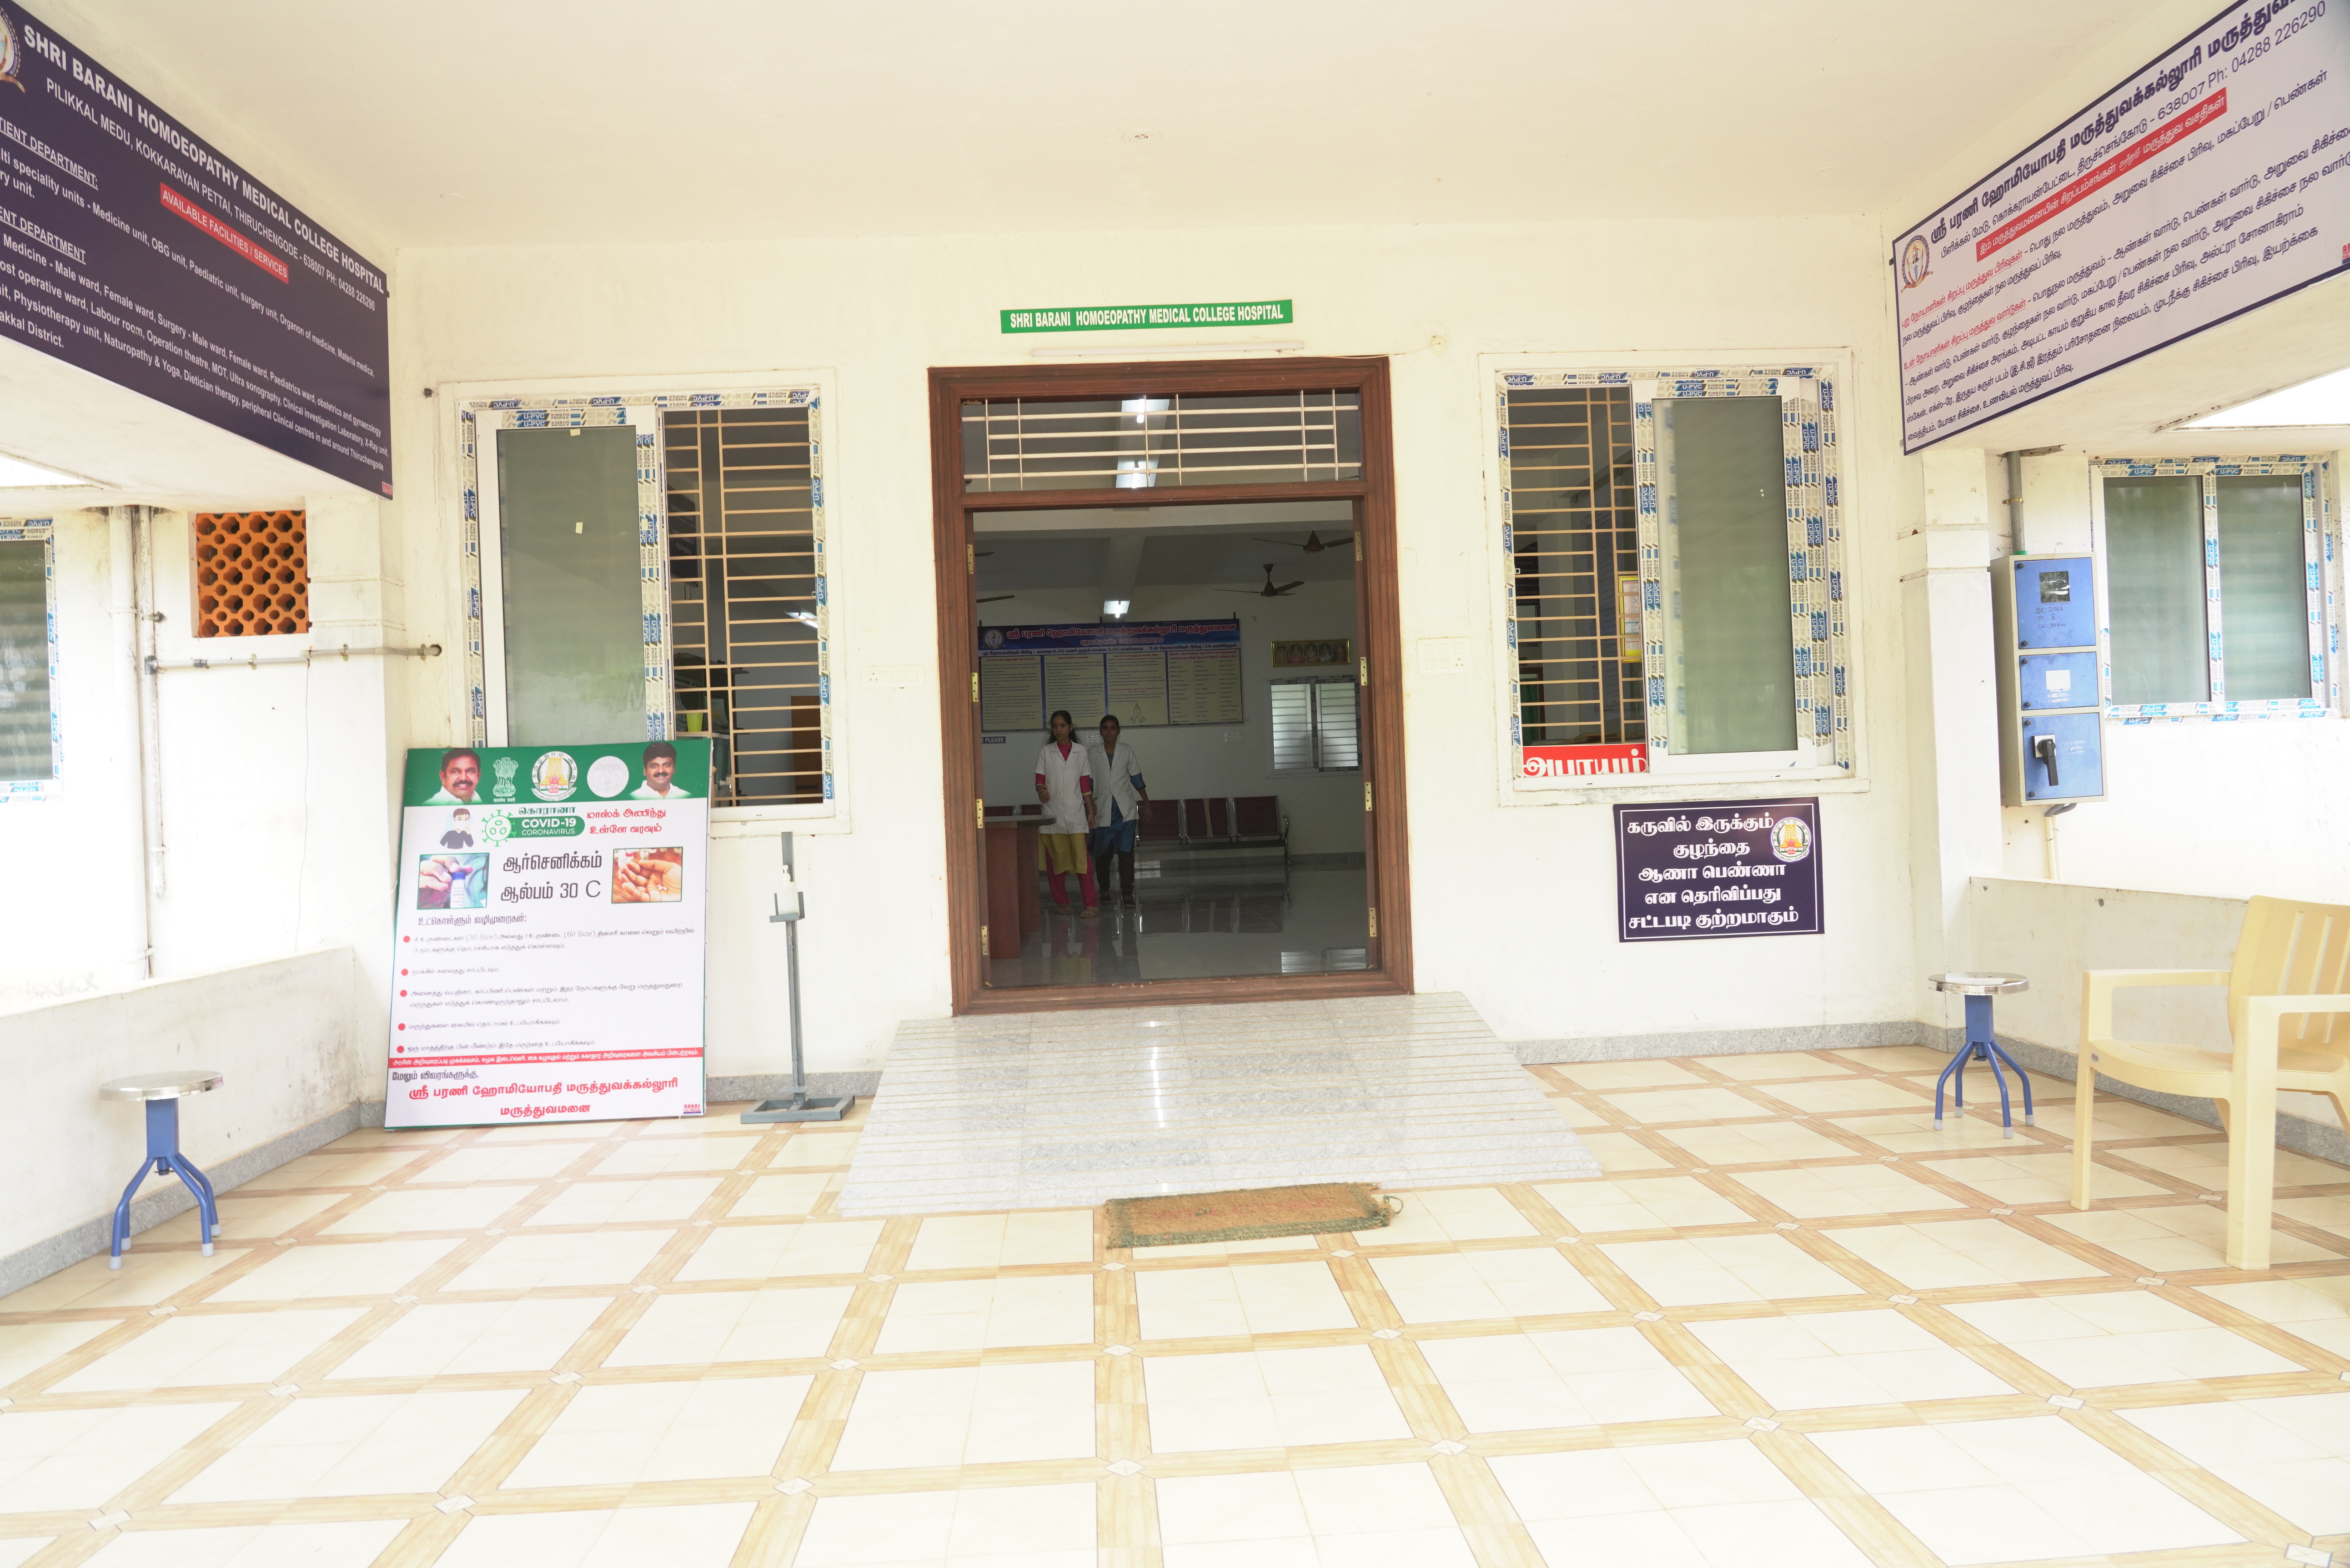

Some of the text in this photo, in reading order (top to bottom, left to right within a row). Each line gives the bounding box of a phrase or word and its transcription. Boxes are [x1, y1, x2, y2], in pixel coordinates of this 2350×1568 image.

[1941, 231, 1971, 259] பிளிக்கல்
[1972, 220, 1991, 238] மேடு,
[2077, 118, 2148, 176] திருச்செங்கோடு
[2158, 80, 2205, 120] 638007
[2208, 67, 2228, 89] Ph:
[2231, 36, 2271, 73] 04288
[2275, 1, 2325, 46] 226290
[1949, 196, 1978, 230] பரணி
[1981, 138, 2066, 208] ஹோமியோபதி
[2070, 45, 2202, 150] மருத்துவக்கல்லூரி
[24, 24, 66, 71] SHRI
[72, 57, 133, 117] BARANI
[138, 104, 239, 191] HOMOEOPATHY
[242, 179, 292, 230] MEDICAL
[294, 218, 339, 264] COLLEGE
[341, 251, 384, 295] HOSPITAL
[30, 136, 98, 188] DEPARTMENT:
[1980, 239, 1992, 256] இம்
[1993, 198, 2059, 246] மருத்துவமனையின்
[2143, 122, 2184, 154] மருத்துவ
[2185, 95, 2224, 128] வசதிகள்
[46, 77, 375, 312] PILIKKAL MEDU, KOKKARAYAN PETTAI, THIRUCHENGODE 638007 PH: 04288 226290
[163, 190, 287, 278] AVAILABLE FACILITIES SERVICES
[1902, 249, 2023, 327] புற நோயாளிகள் சிறப்பு மருத்துவ பிரிவுகள்
[1903, 250, 2062, 347] நல மருத்துவப் பிரிவு, குழந்தைகள் நல மருத்துவப் பிரிவு.
[1010, 304, 1284, 328] SHRI BARANI HOMOEOPATHY MEDICAL COLLEGE HOSPITAL
[28, 320, 64, 348] District.
[14, 289, 384, 471] Physiotherapy unit, Naturopathy Yoga, Dietician therapy, peripheral Clinical centres in and around Thiruchengode
[1908, 363, 2074, 441] வைத்தியம், யோகா சிகிச்சை, உணவியல் மருத்துவப் பிரிவு.
[1021, 628, 1045, 639] பரணி
[1046, 626, 1105, 638] ஹோமியோபதி
[1105, 624, 1178, 637] மருத்துவக்கல்லூரி
[1178, 622, 1237, 635] மருத்துவமனை
[518, 807, 576, 815] கொரானா
[522, 818, 577, 828] COVID-19
[587, 808, 666, 819] மாஸ்க் அணிந்து
[521, 828, 575, 836] CORONAVIRUS
[589, 823, 662, 834] உள்ளே வரவும்
[1627, 812, 1775, 837] கருவில் இருக்கும்
[1673, 838, 1750, 860] குழந்தை
[503, 850, 602, 874] ஆர்செனிக்கம்
[1638, 858, 1788, 883] ஆணா பெண்ணா
[501, 880, 601, 903] ஆல்பம் 30 C
[1645, 884, 1781, 906] என தெரிவிப்பது
[418, 913, 527, 926] உட்கொள்ளும் வழிமுறைகள்:
[1628, 905, 1799, 930] சட்டபடி குற்றமாகும்
[433, 1085, 468, 1099] பரணி
[472, 1082, 562, 1098] ஹோமியோபதி
[567, 1077, 678, 1095] மருத்துவக்கல்லூரி
[500, 1104, 591, 1119] மருத்துவமனை
